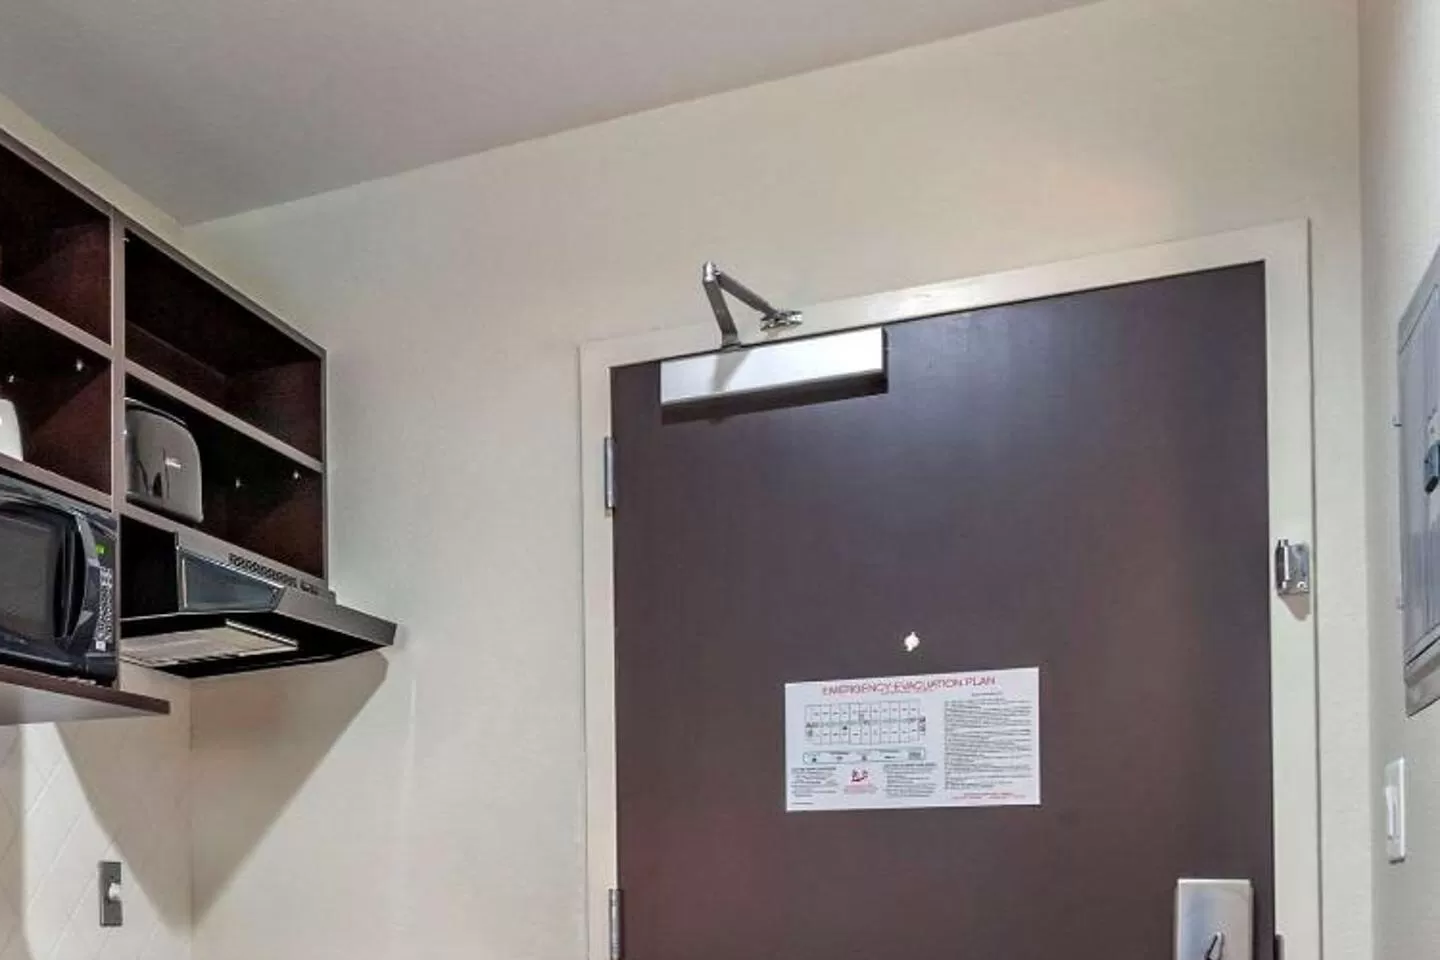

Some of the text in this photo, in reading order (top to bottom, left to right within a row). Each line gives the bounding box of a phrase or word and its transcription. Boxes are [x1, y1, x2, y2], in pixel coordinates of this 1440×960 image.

[822, 683, 891, 696] EMERGENCY
[893, 679, 960, 692] EVACUATION
[964, 676, 996, 687] PLAN
